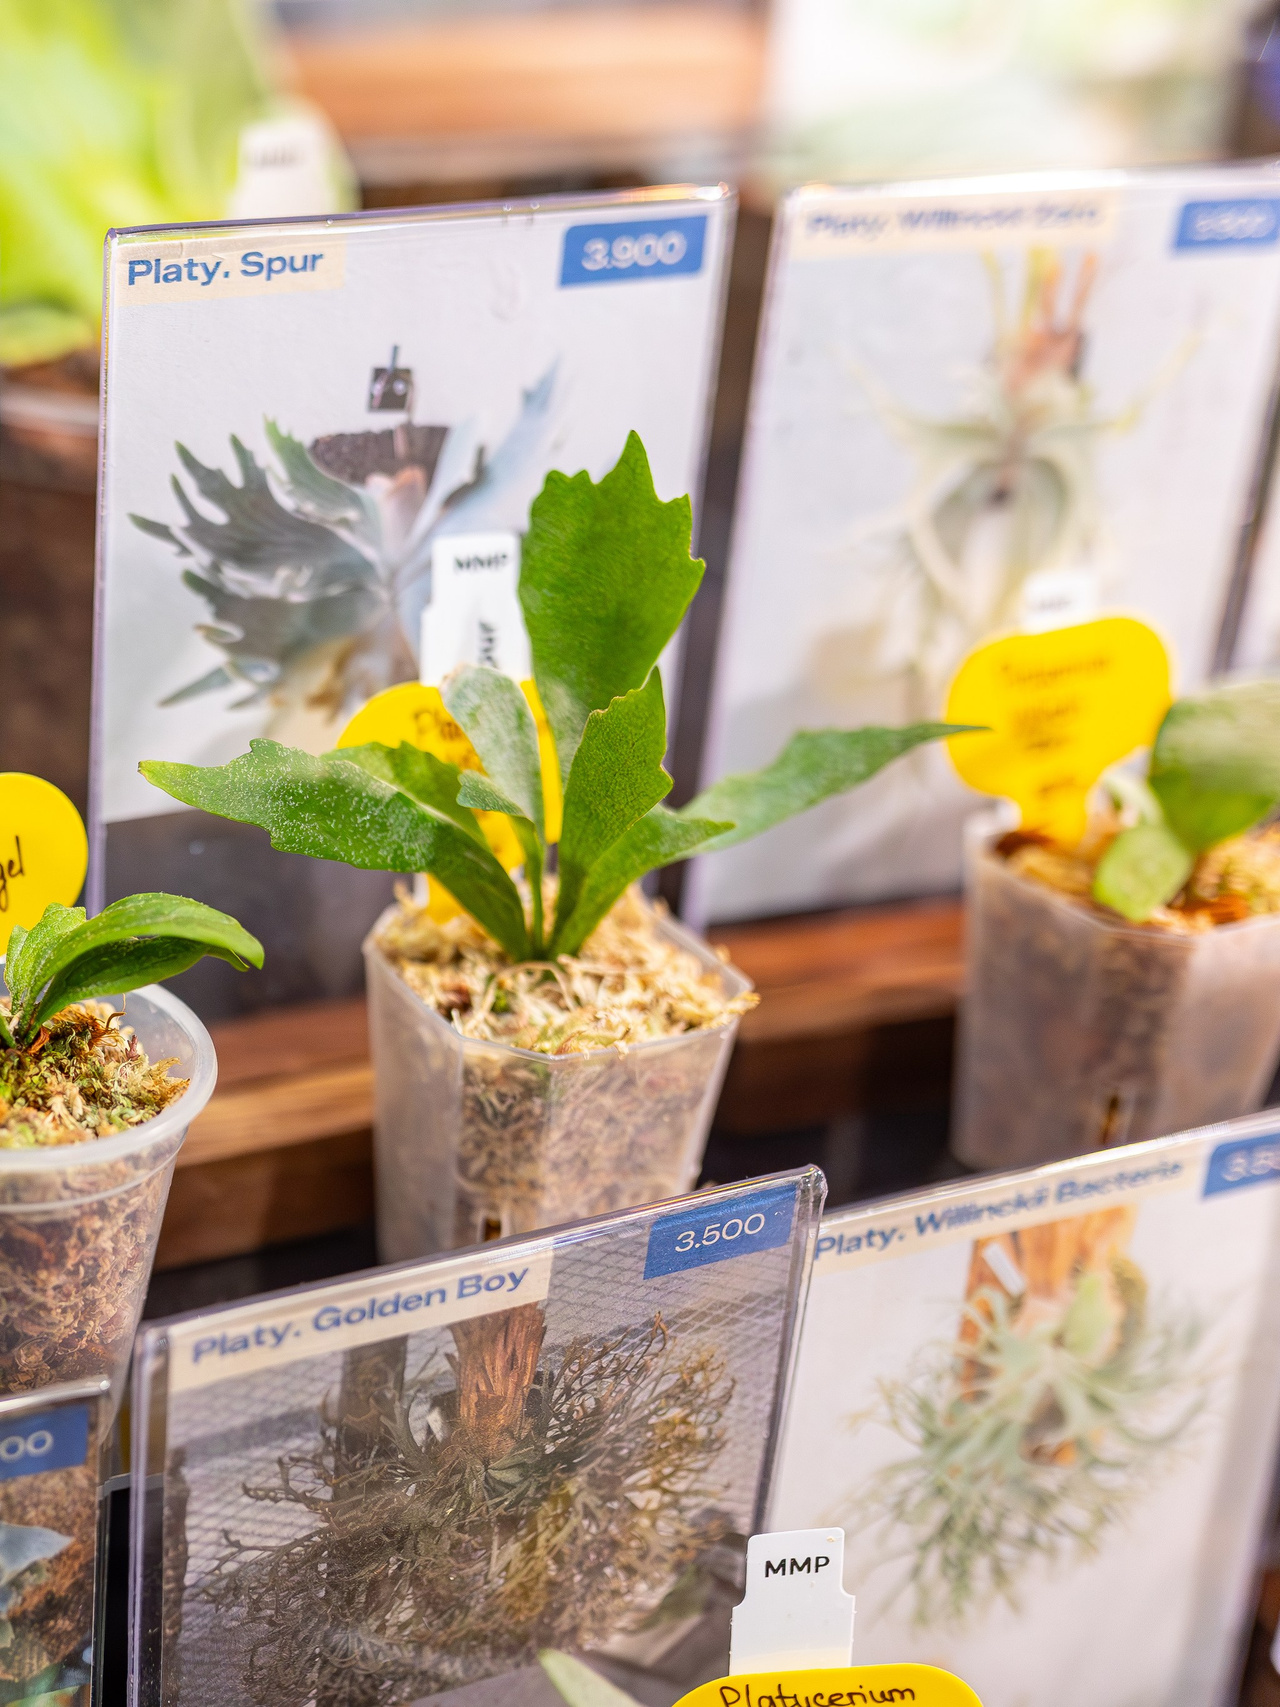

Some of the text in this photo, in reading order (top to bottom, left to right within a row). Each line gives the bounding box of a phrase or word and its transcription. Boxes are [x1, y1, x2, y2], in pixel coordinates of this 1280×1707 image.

[127, 250, 325, 286] Platy. Spur
[581, 231, 687, 271] 3.900
[674, 1211, 766, 1254] 3.500
[815, 1224, 905, 1261] Platy.
[191, 1264, 530, 1364] Platy. Golden Boy
[764, 1555, 830, 1579] MMP
